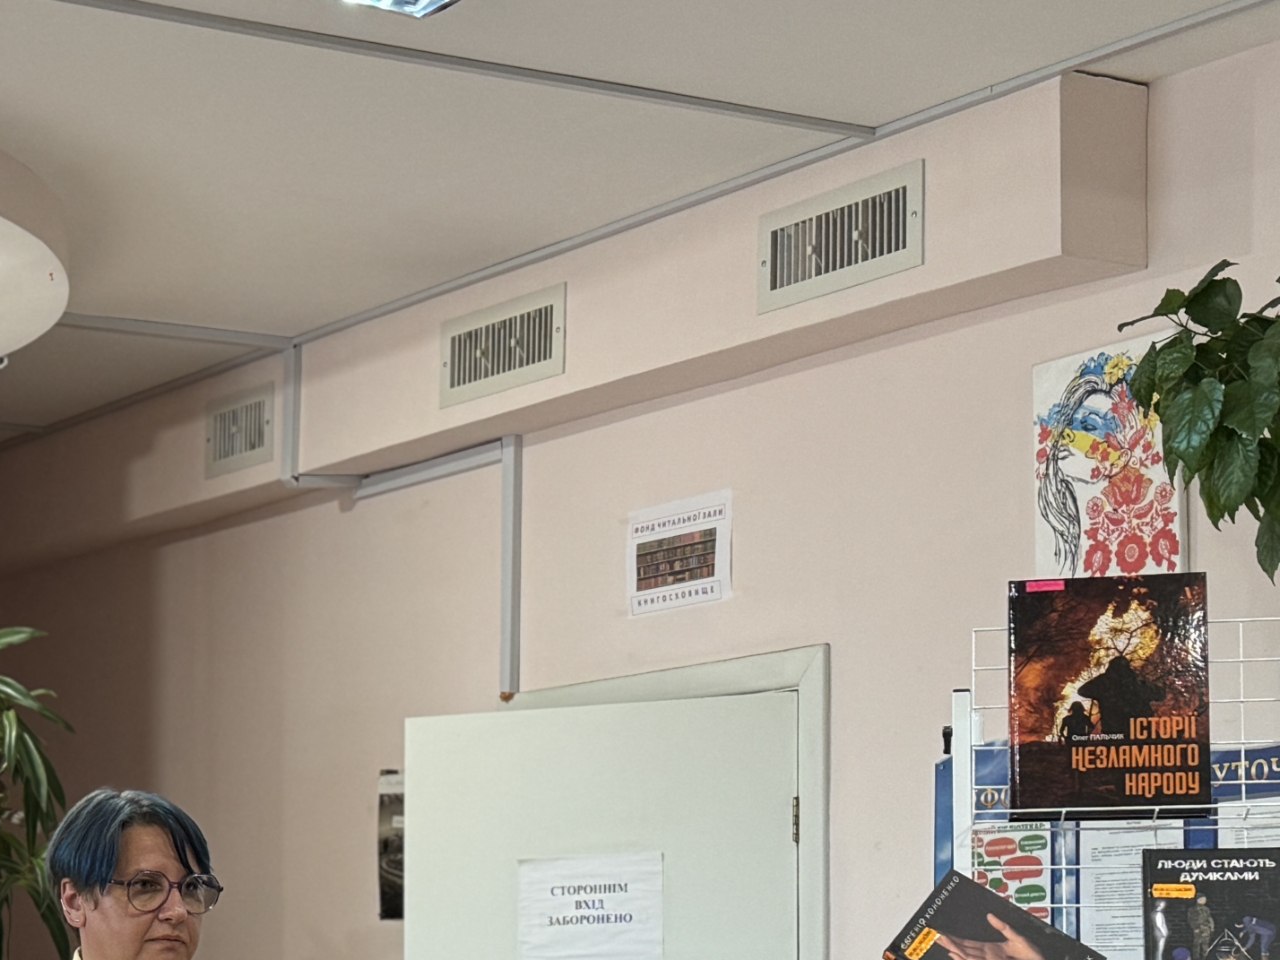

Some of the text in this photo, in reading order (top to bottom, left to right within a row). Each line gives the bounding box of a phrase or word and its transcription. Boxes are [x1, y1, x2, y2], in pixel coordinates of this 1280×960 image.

[638, 585, 714, 607] КНИГОСХОВИЩЕ
[1072, 744, 1199, 772] НЕЗЛАМНОГО
[1125, 772, 1199, 798] НАРОДУ
[1157, 859, 1276, 870] ЛЮДИ СТАЮТЬ
[1180, 872, 1259, 882] ДУМКАМИ
[550, 882, 629, 897] СТОРОННІМ
[574, 899, 605, 912] ВХІД
[547, 912, 633, 927] ЗАБОРОНЕНО
